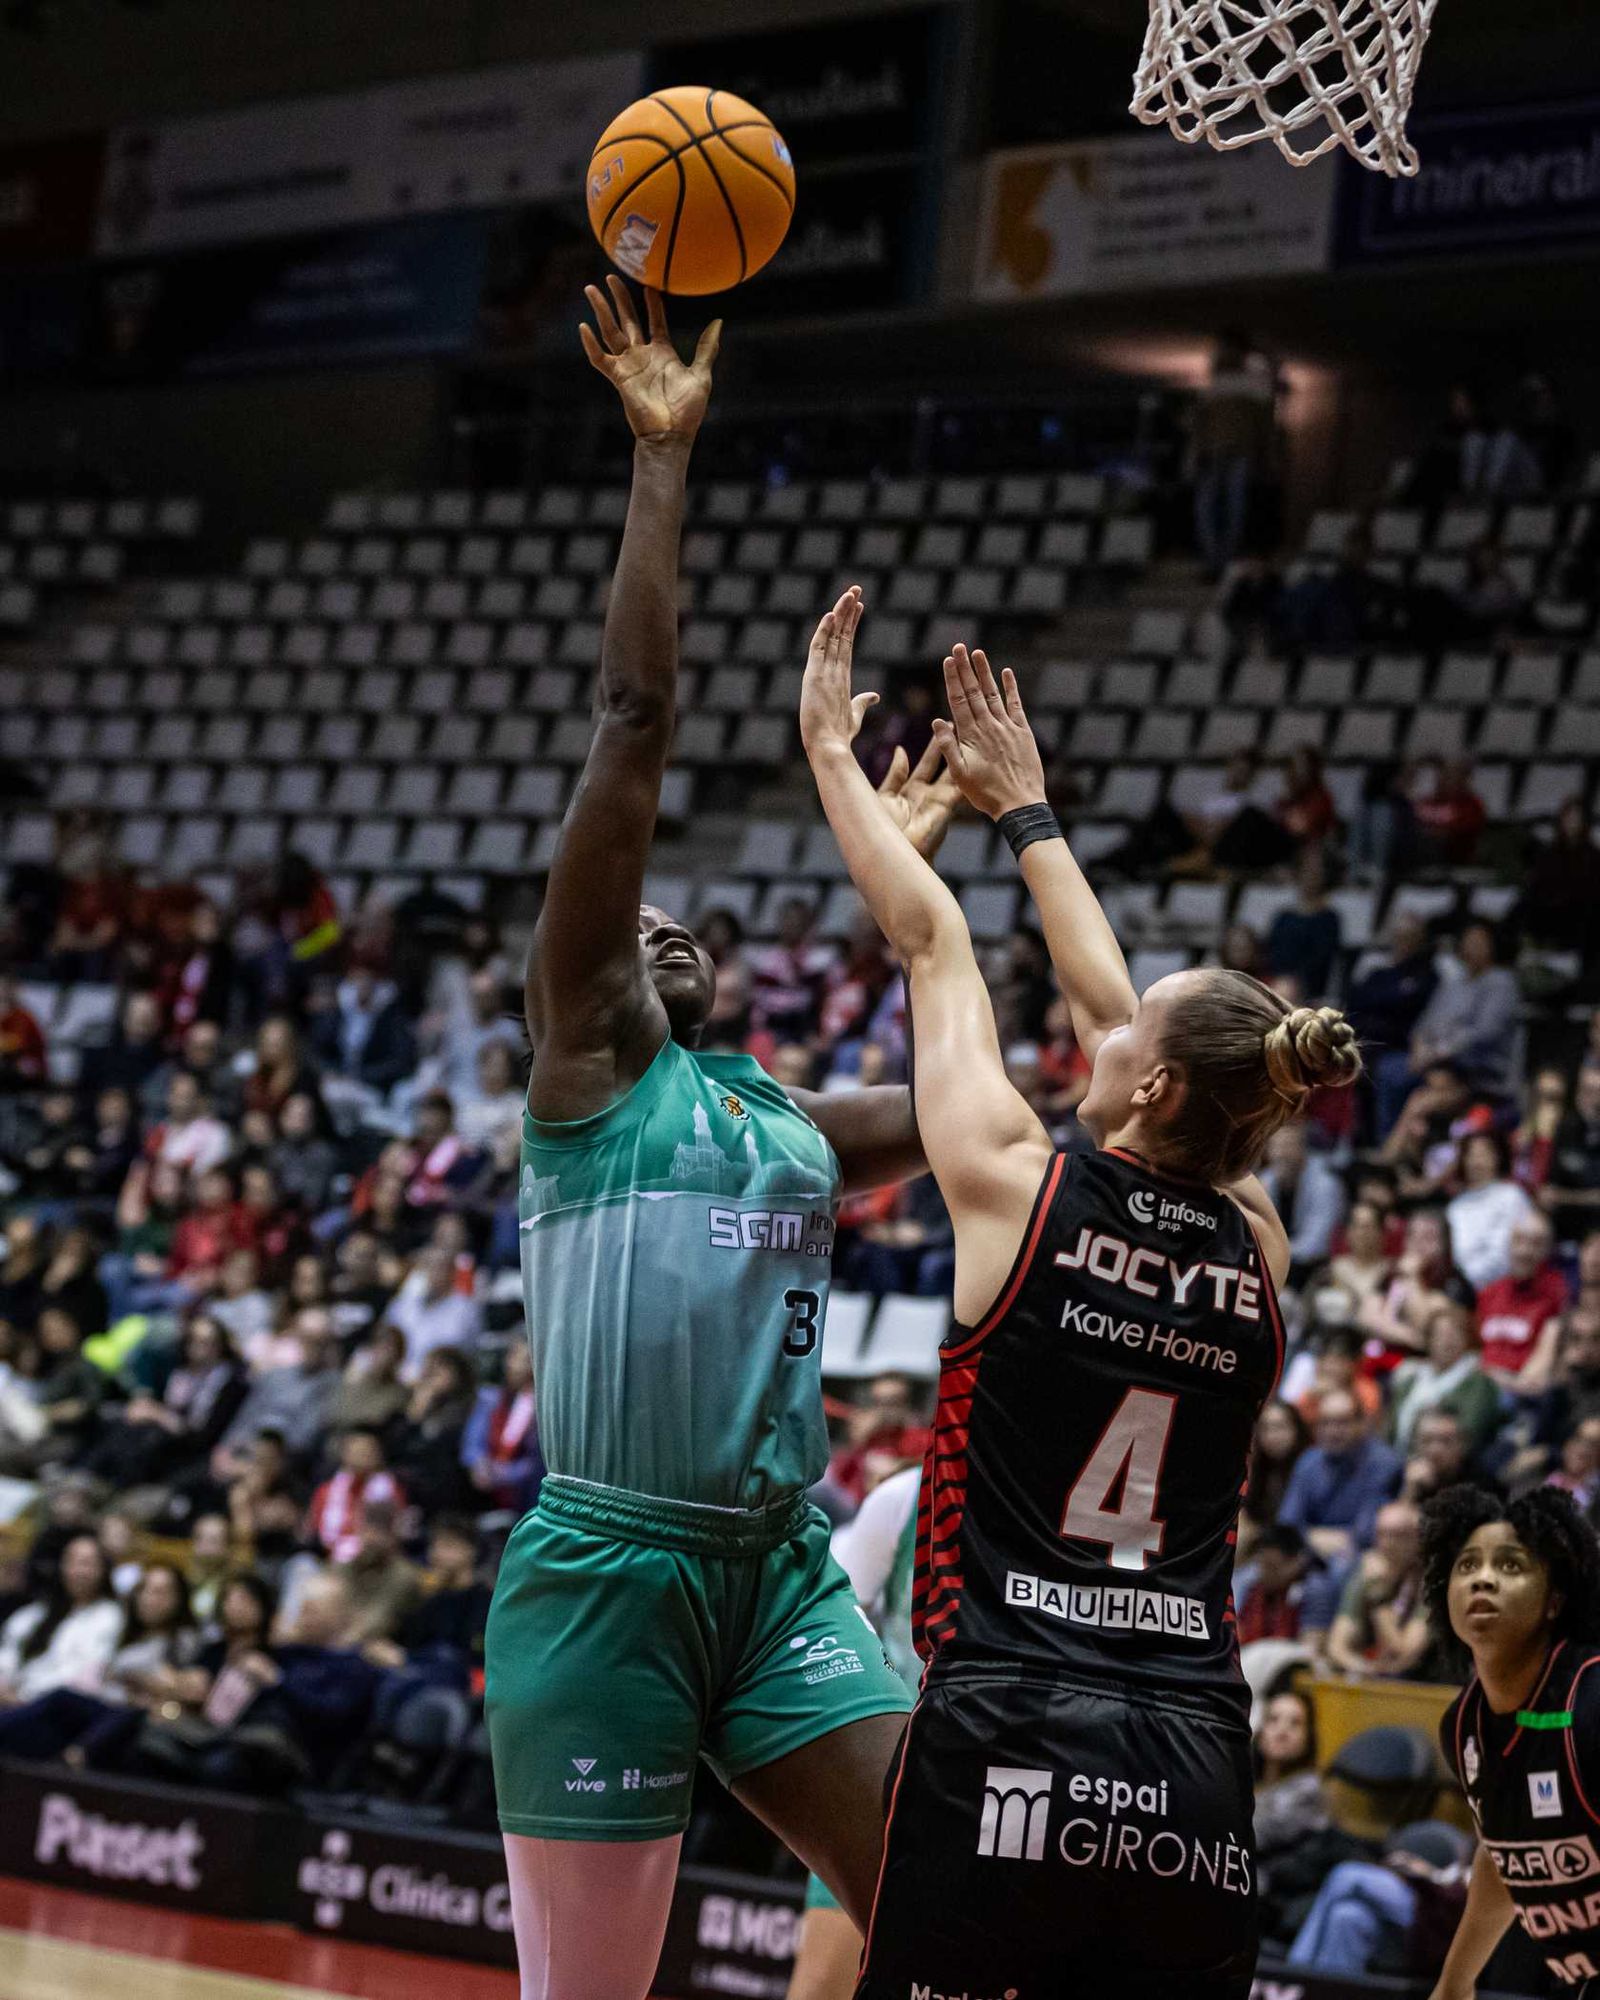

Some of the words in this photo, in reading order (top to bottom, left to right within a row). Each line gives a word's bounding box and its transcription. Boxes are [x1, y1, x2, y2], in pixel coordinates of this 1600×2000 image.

[709, 1206, 804, 1252] SGM
[782, 1288, 821, 1358] 3
[1060, 1301, 1144, 1346] Kave
[1148, 1330, 1237, 1373] Home
[1062, 1387, 1177, 1570] 4
[1010, 1576, 1206, 1634] BAUHAUS
[565, 1779, 606, 1792] vive
[1069, 1775, 1167, 1815] espai
[1060, 1818, 1250, 1895] GIRONÈS
